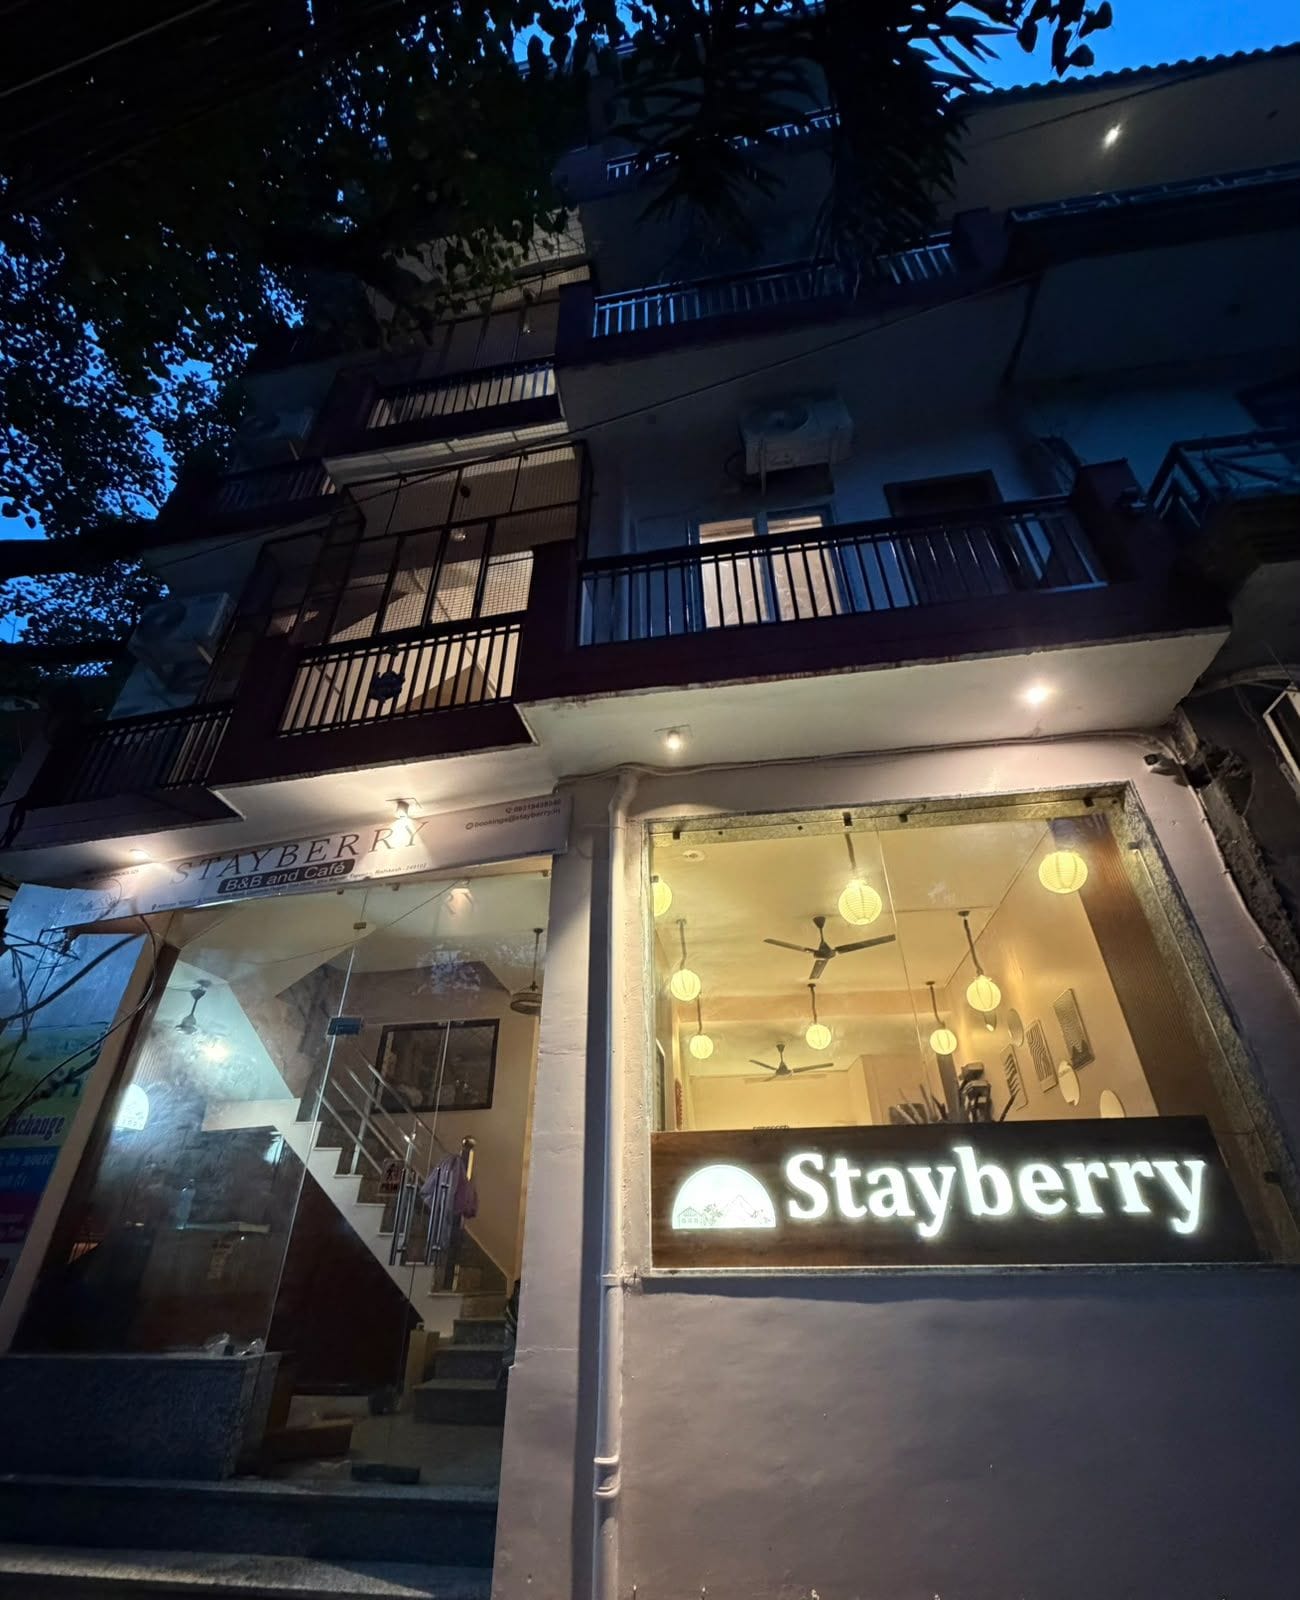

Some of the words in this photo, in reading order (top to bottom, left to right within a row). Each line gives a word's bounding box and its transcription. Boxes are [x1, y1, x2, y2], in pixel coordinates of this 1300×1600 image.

[169, 820, 428, 886] STAYBERRY
[225, 877, 261, 891] B&B
[266, 869, 300, 885] and
[304, 862, 345, 879] Café
[784, 1146, 1206, 1237] Stayberry
